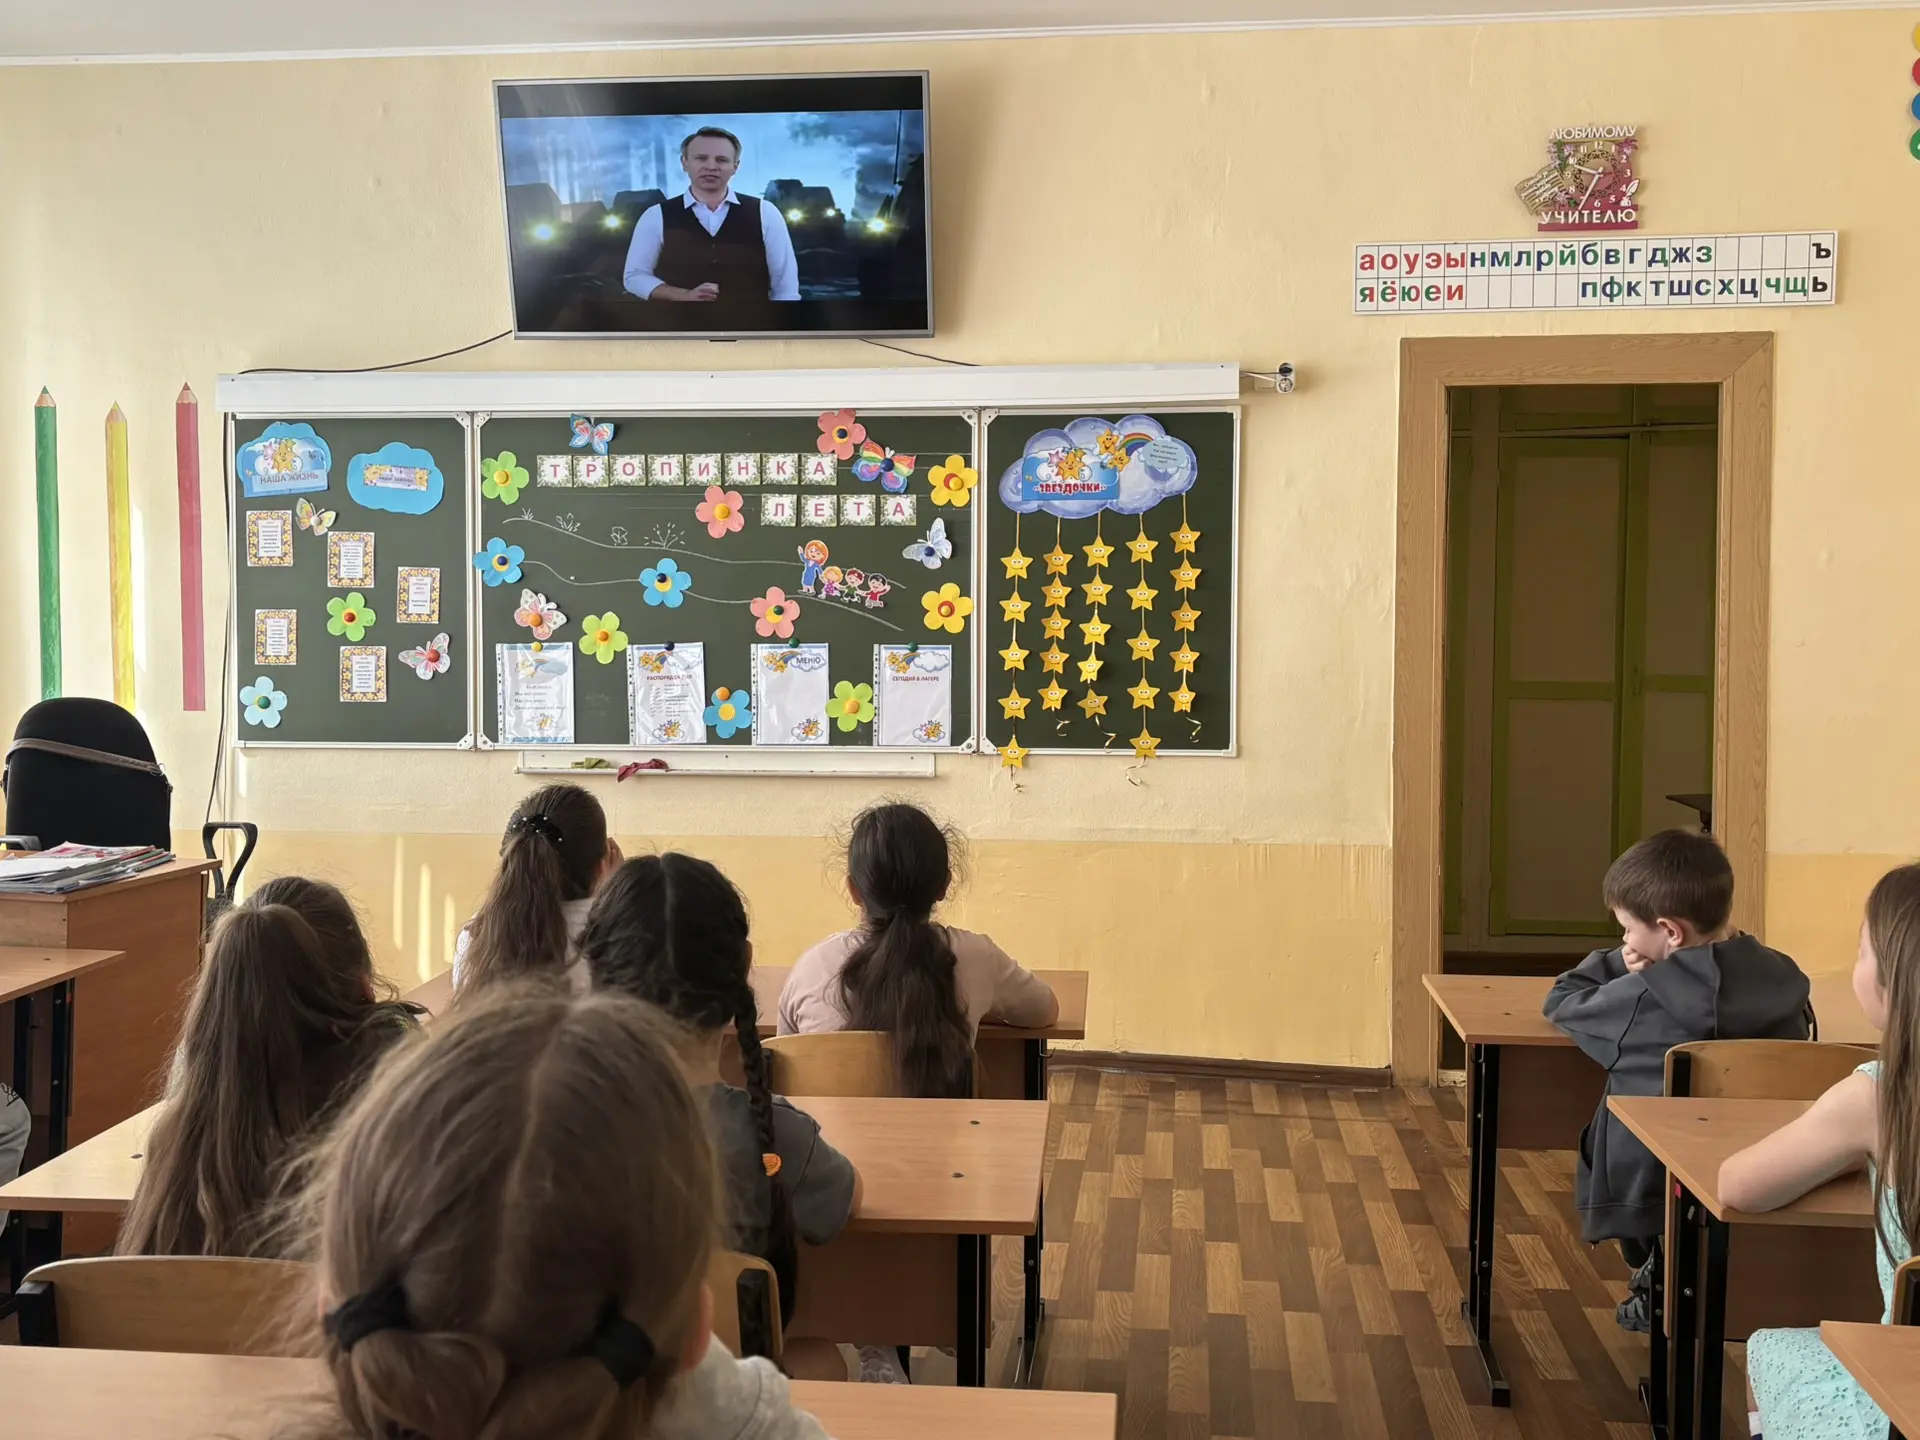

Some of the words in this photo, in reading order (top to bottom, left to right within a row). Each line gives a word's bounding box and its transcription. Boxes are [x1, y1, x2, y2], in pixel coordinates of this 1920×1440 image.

[1549, 124, 1638, 140] ЛЮБИМОМУ
[1594, 141, 1603, 150] 12
[1621, 155, 1627, 163] 2
[1624, 169, 1631, 177] 3
[1569, 186, 1576, 194] 8
[1620, 184, 1626, 192] 4
[1594, 200, 1601, 208] 6
[1609, 196, 1616, 204] 5
[1541, 208, 1636, 224] УЧИТЕЛЮ
[549, 461, 826, 478] ТРОПИНКА
[260, 474, 287, 484] НАША
[288, 472, 318, 481] ЖИЗНЬ
[772, 502, 905, 518] ЛЕТА
[796, 656, 821, 665] МЕНЮ
[892, 675, 916, 683] СЕГОДНЯ
